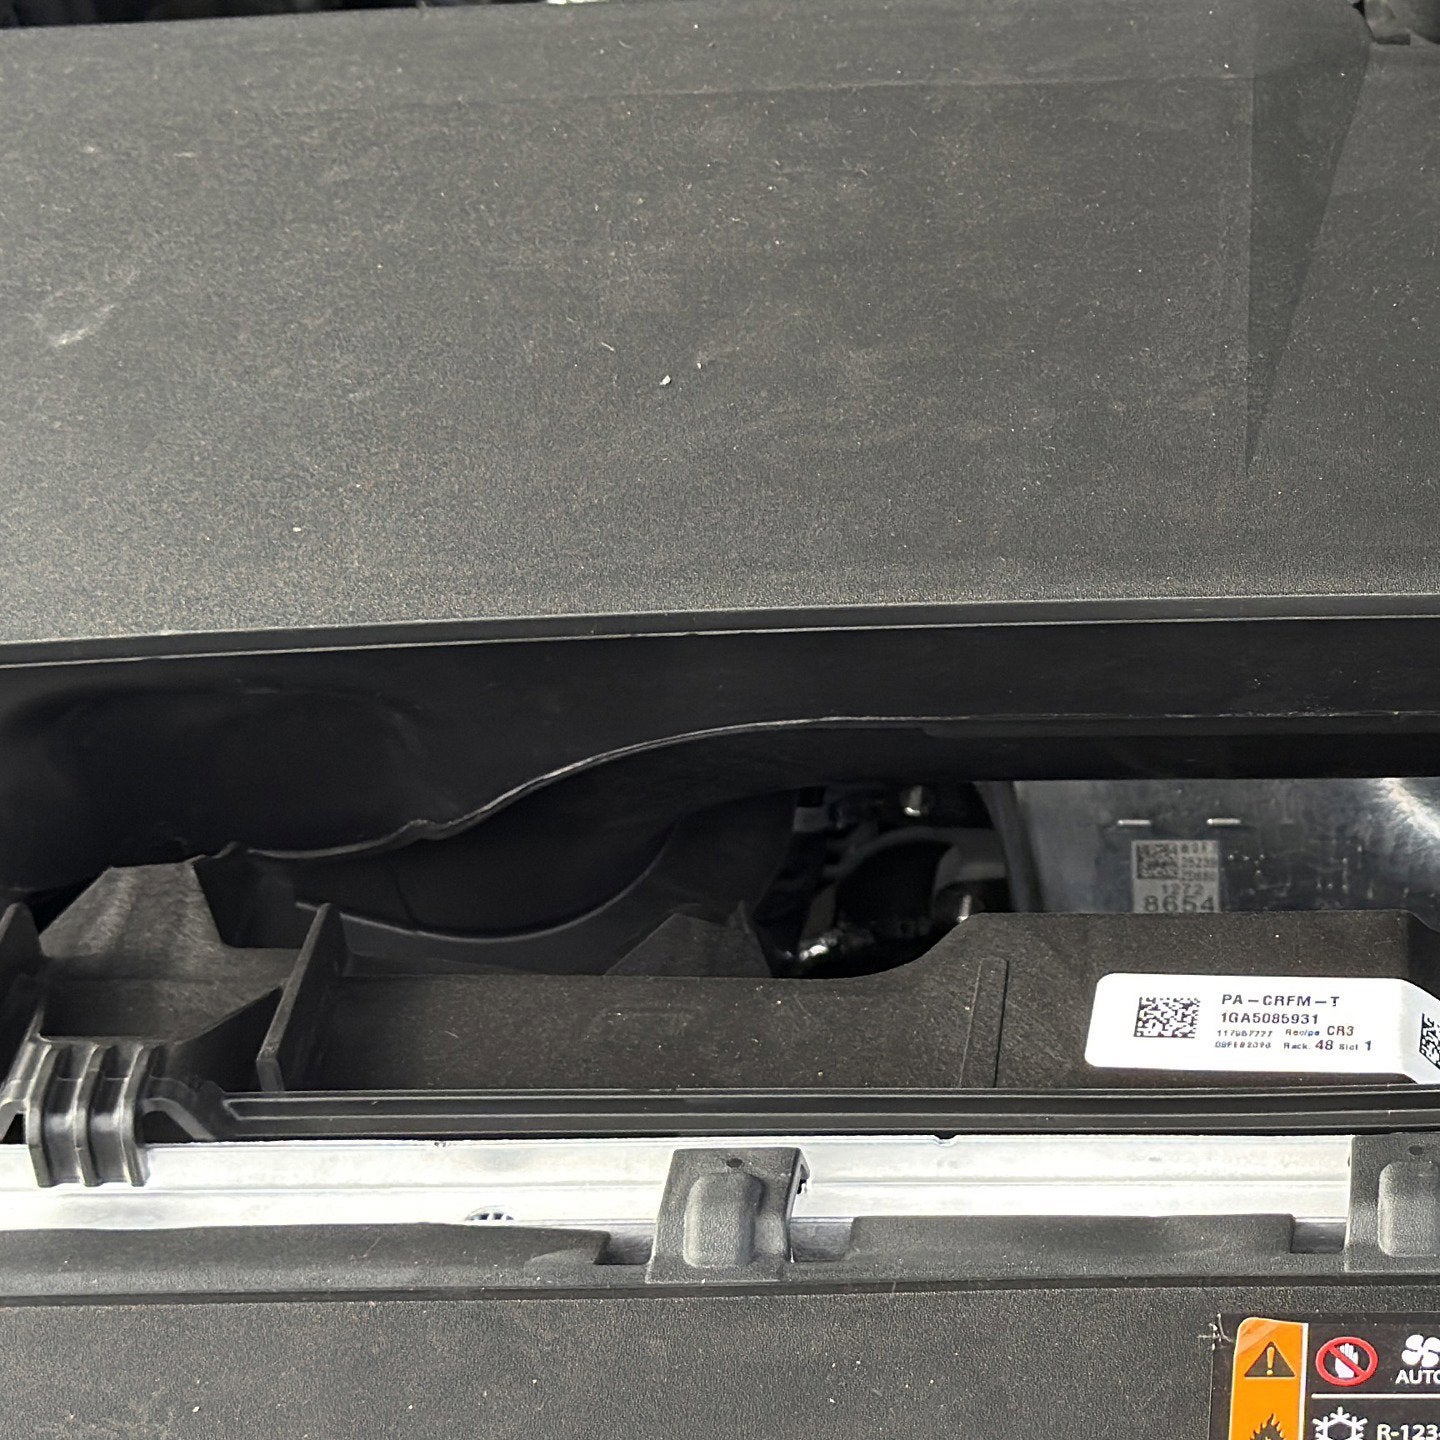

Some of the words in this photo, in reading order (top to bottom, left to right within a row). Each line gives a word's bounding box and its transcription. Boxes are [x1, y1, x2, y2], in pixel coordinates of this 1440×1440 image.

[1327, 1025, 1354, 1036] CR3
[1315, 1039, 1333, 1050] 48
[1364, 1040, 1371, 1051] 1
